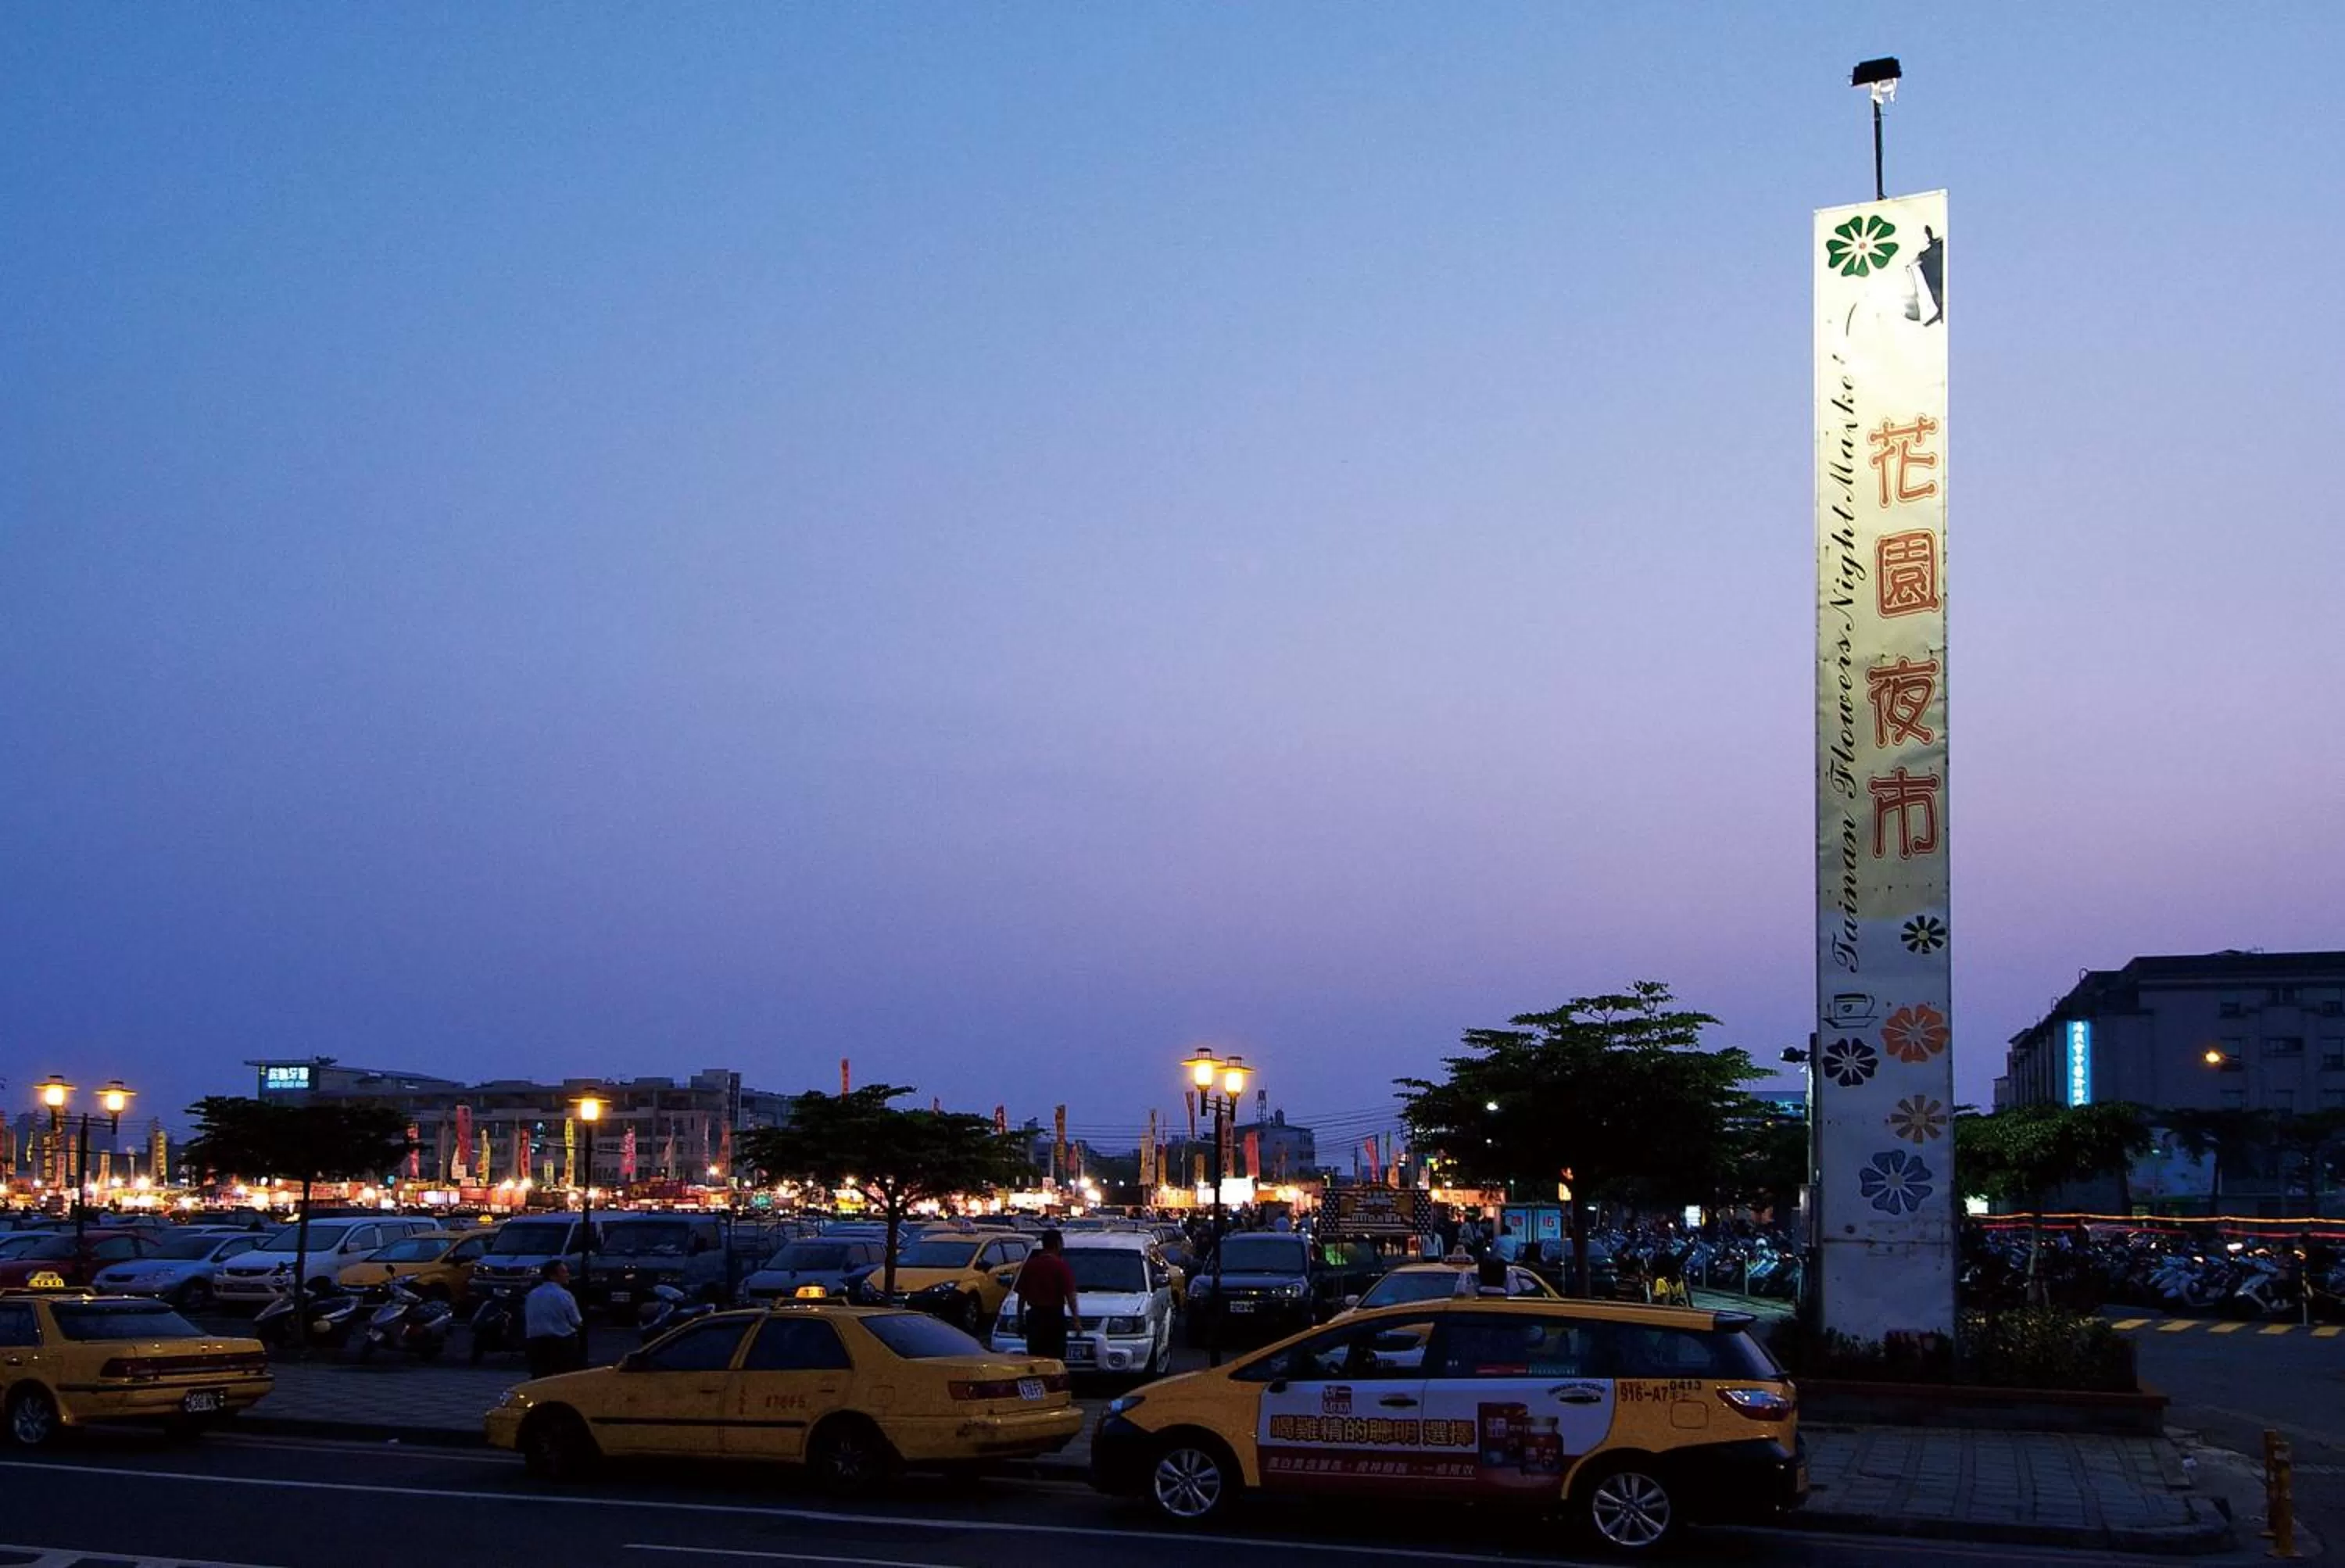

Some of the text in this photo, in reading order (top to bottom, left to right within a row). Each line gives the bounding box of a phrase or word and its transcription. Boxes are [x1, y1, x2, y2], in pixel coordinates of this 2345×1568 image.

[1825, 353, 1867, 973] Tainan Flowers Night Marke
[1866, 413, 1942, 858] 花園夜市
